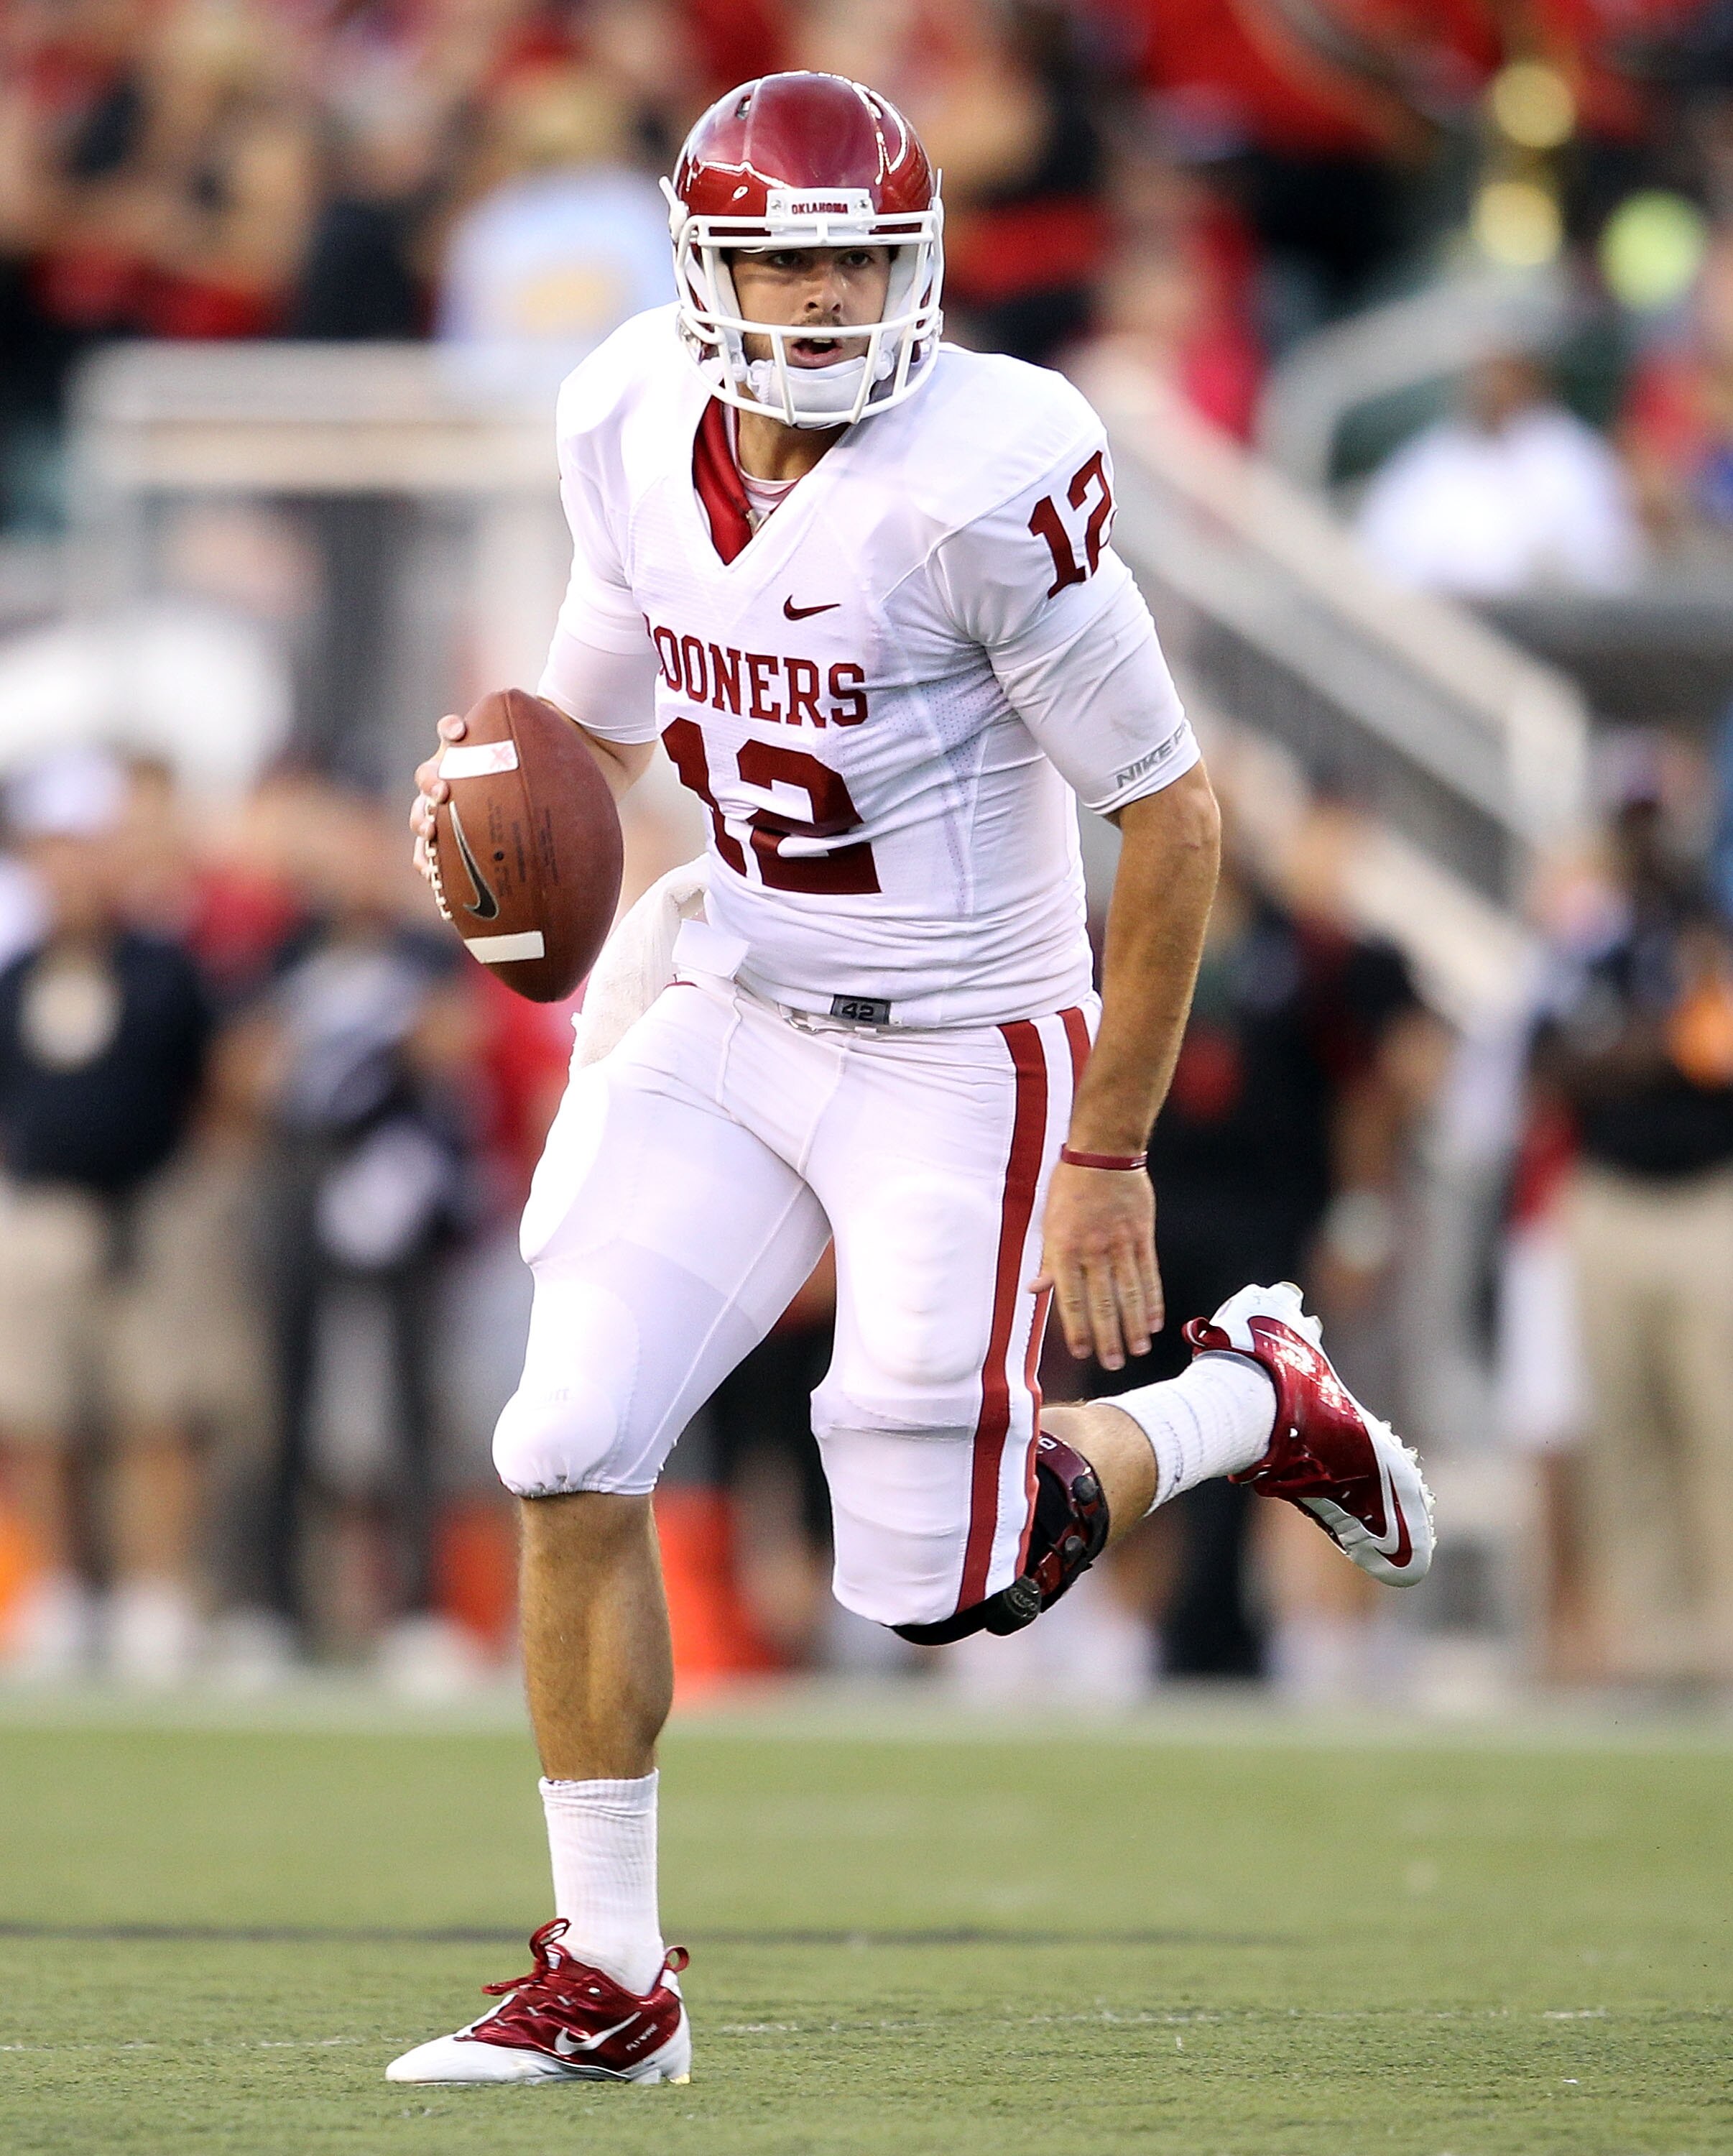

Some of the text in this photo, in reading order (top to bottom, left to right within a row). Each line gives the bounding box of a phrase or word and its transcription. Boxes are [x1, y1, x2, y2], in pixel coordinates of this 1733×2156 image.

[792, 203, 849, 214] OKLAHOMA
[1028, 450, 1118, 599] 12
[642, 612, 868, 728] OONERS
[1116, 739, 1173, 788] NIKE
[661, 717, 882, 894] 12
[841, 1002, 874, 1021] 42
